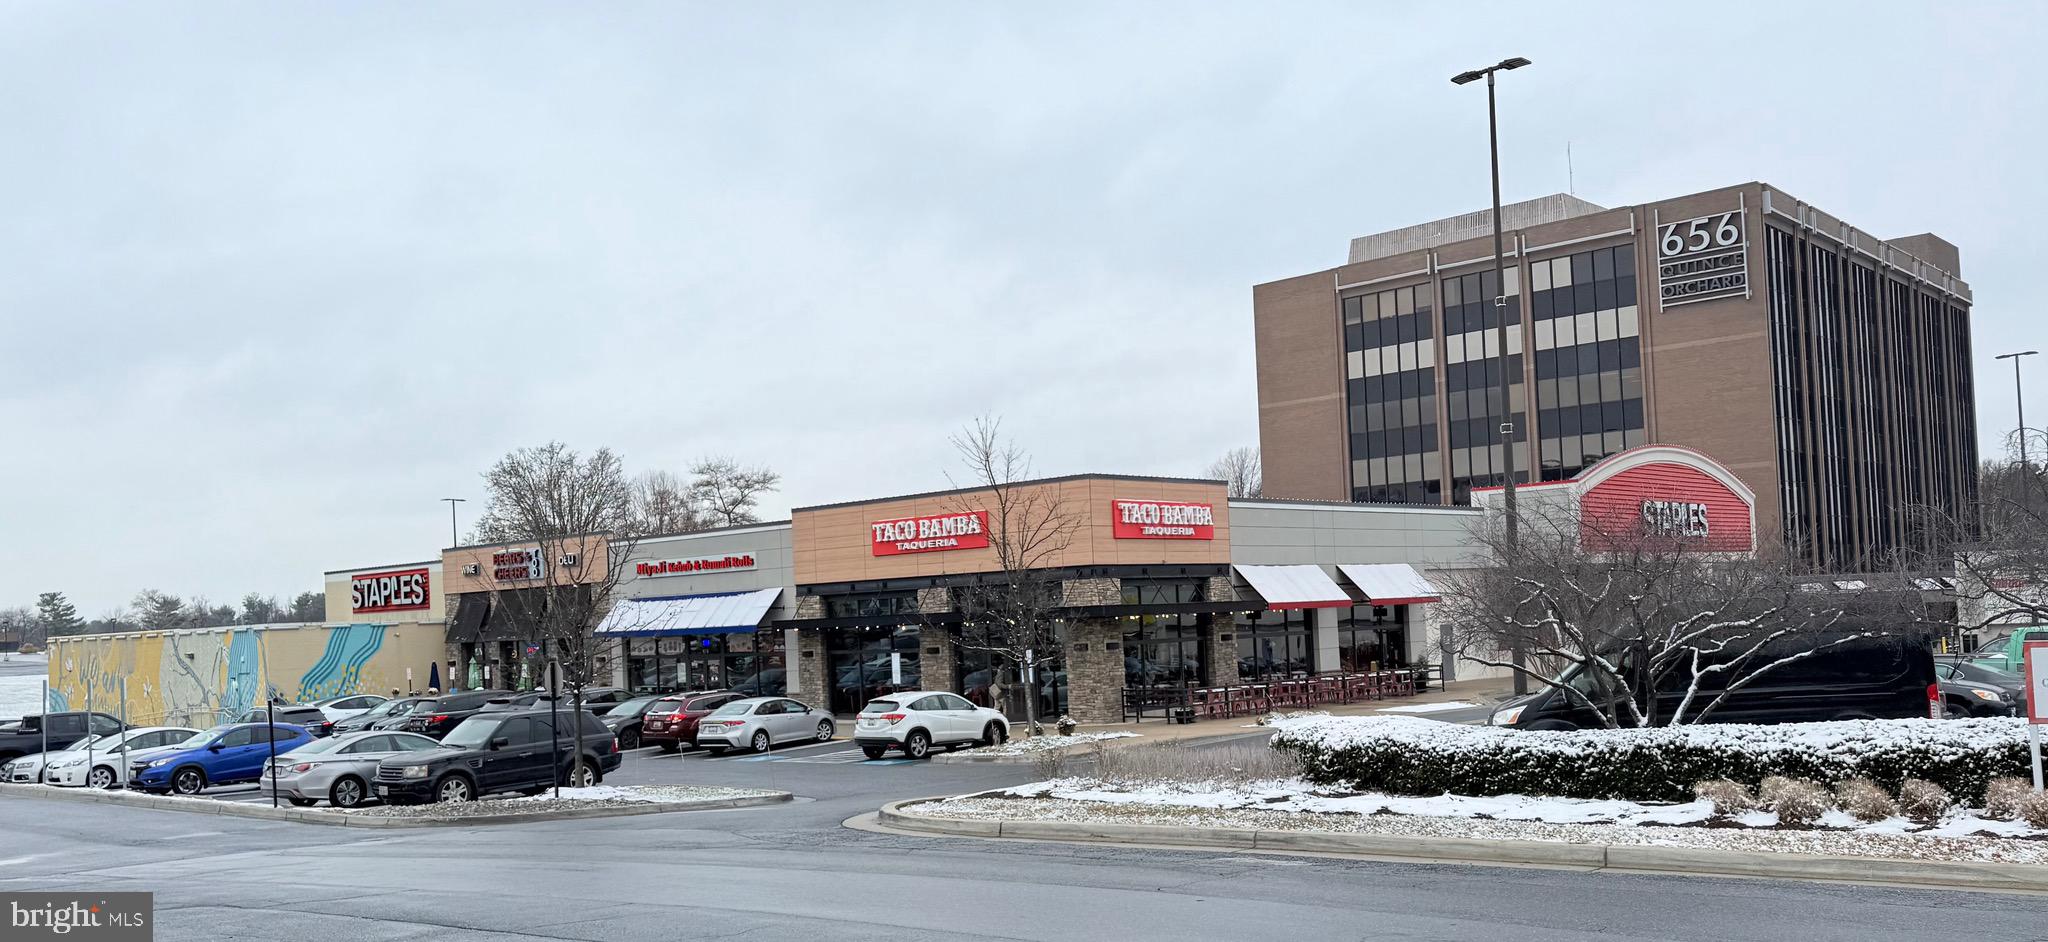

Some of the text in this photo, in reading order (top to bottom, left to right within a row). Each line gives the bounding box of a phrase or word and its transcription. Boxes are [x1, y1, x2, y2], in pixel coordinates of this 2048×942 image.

[1661, 212, 1739, 256] 656
[1661, 254, 1744, 277] QUINCE
[1662, 274, 1744, 297] ORCHARD
[1118, 503, 1214, 526] TACO BAMBA
[1642, 500, 1709, 538] STAPLES
[872, 515, 981, 543] TACO BAMBA
[1141, 526, 1195, 536] TAQUERIA
[896, 538, 958, 550] TAQUERIA
[693, 560, 701, 571] &
[731, 555, 754, 567] Rolls
[352, 574, 424, 609] STAPLES
